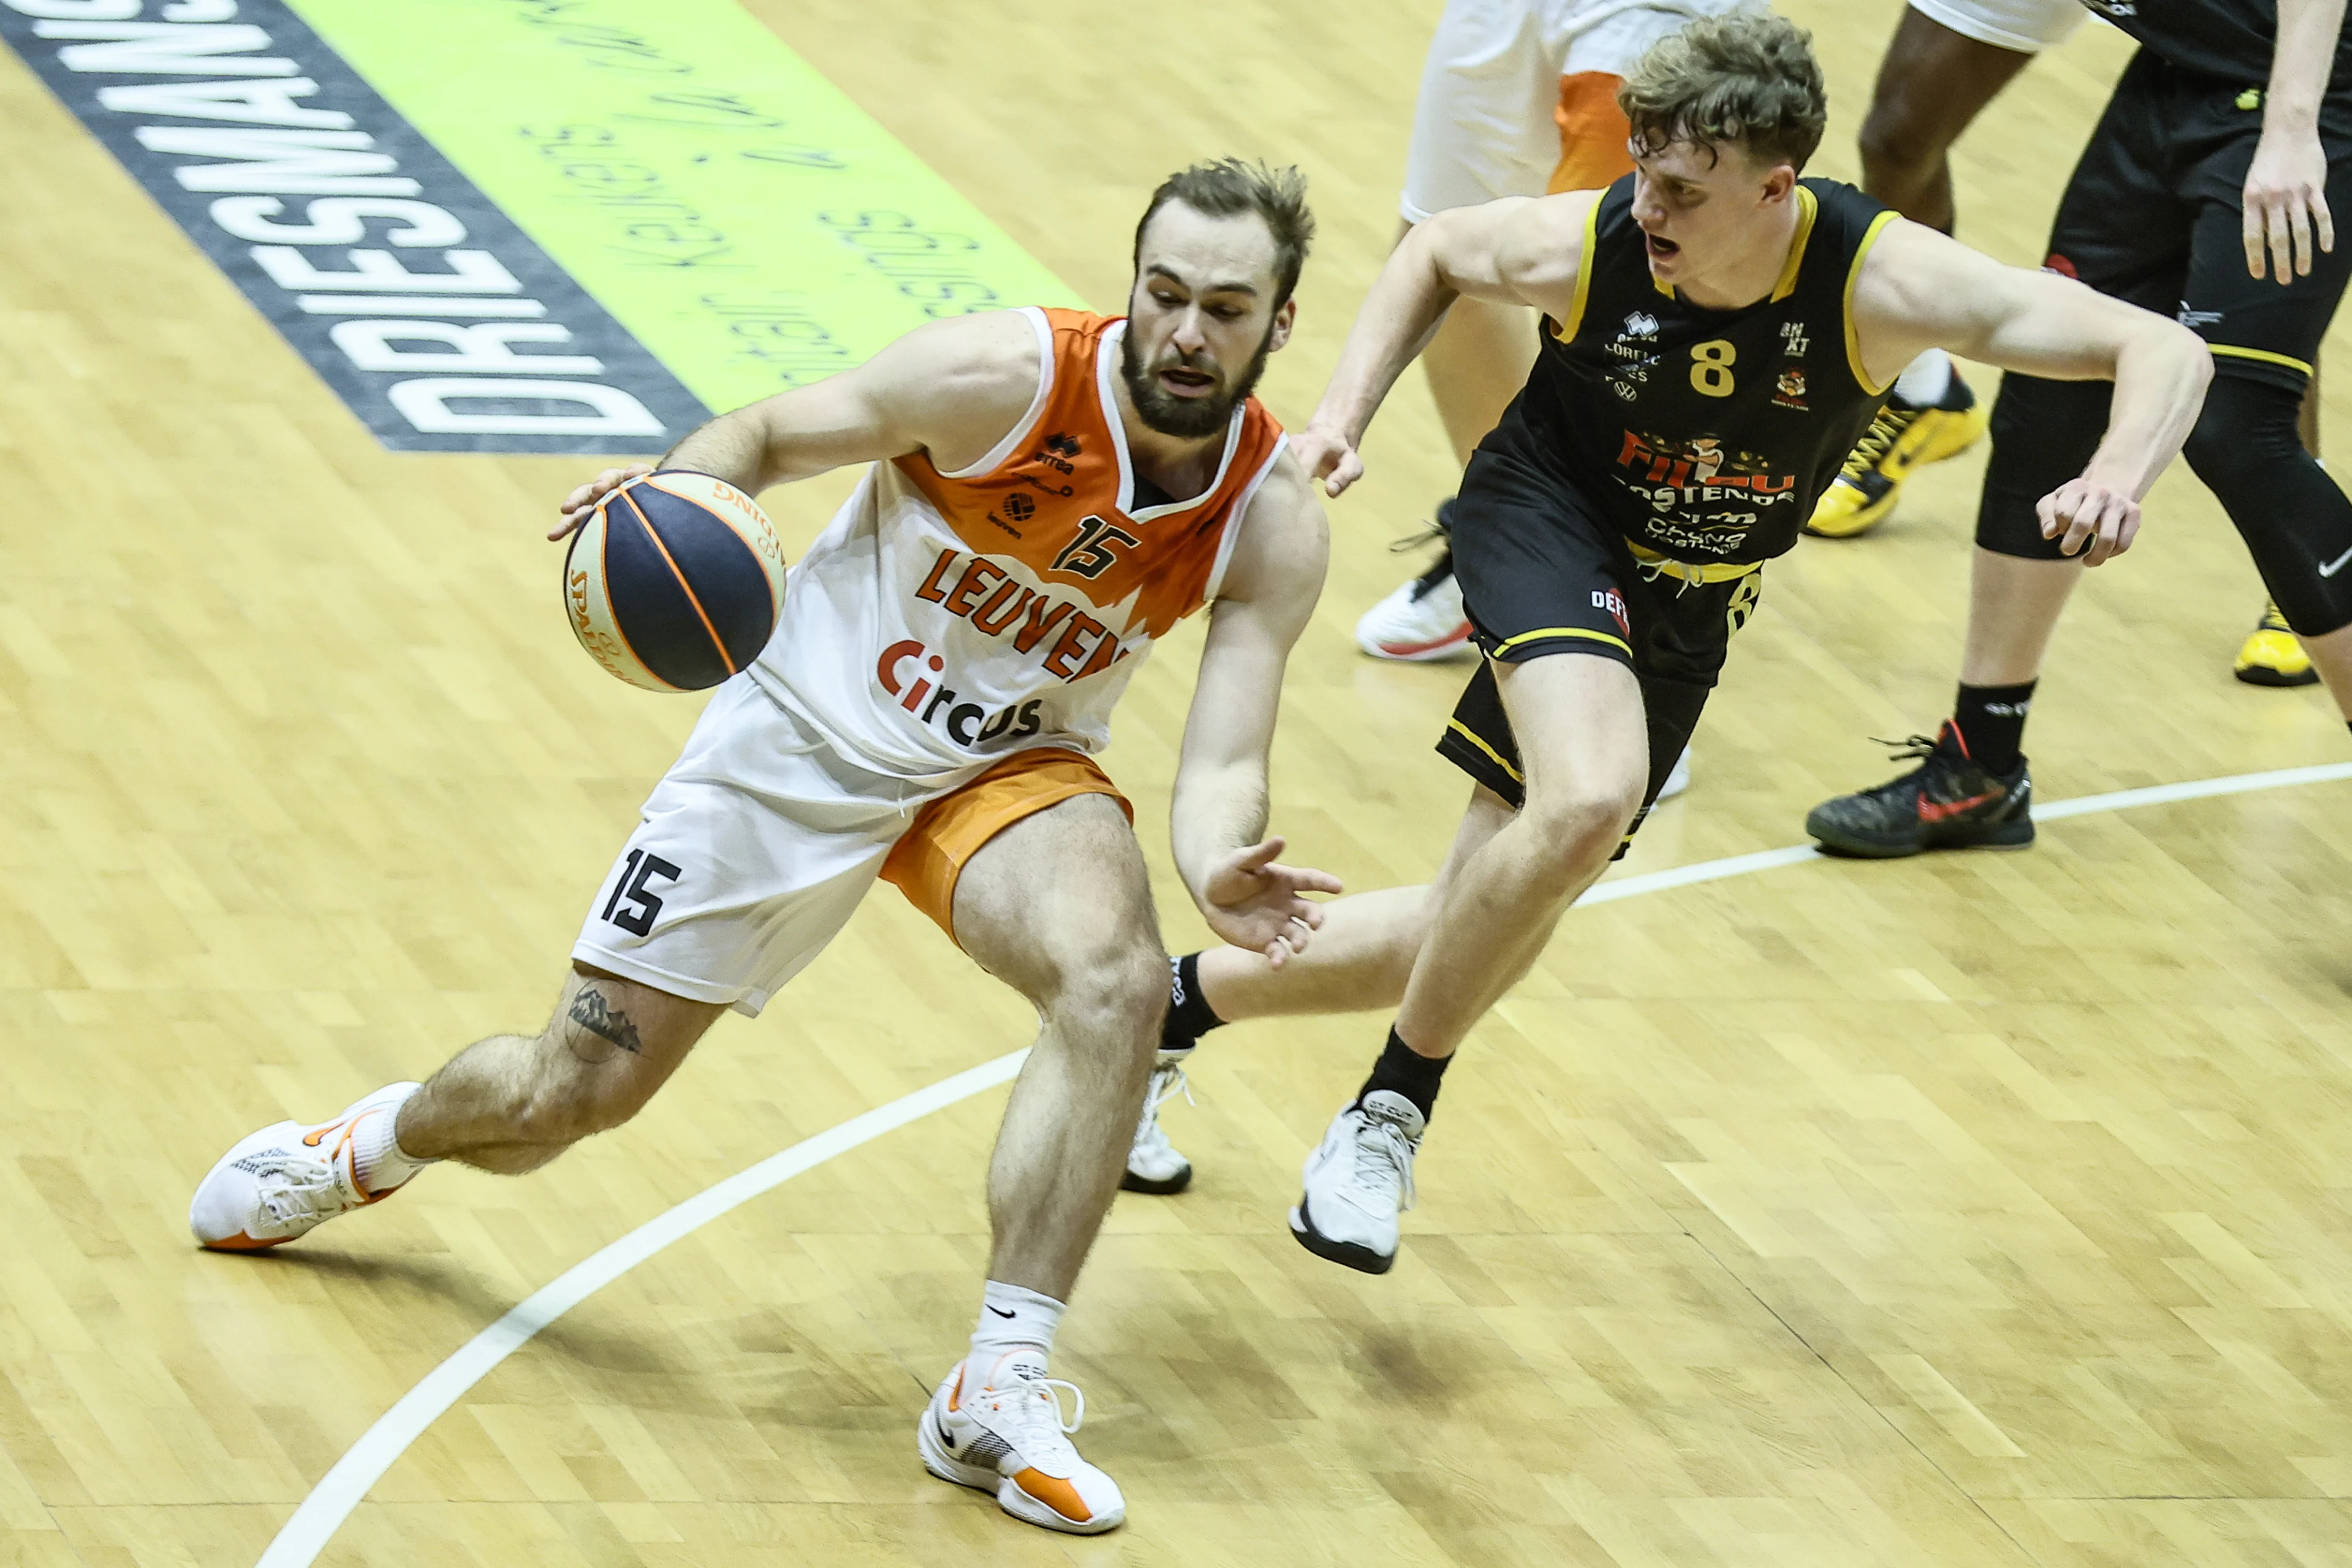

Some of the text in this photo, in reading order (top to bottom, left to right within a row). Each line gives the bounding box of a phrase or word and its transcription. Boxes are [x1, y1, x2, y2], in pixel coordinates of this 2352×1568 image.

[518, 123, 758, 268] Keukens
[1689, 339, 1736, 398] 8
[1048, 514, 1142, 581] 15
[601, 848, 682, 938] 15
